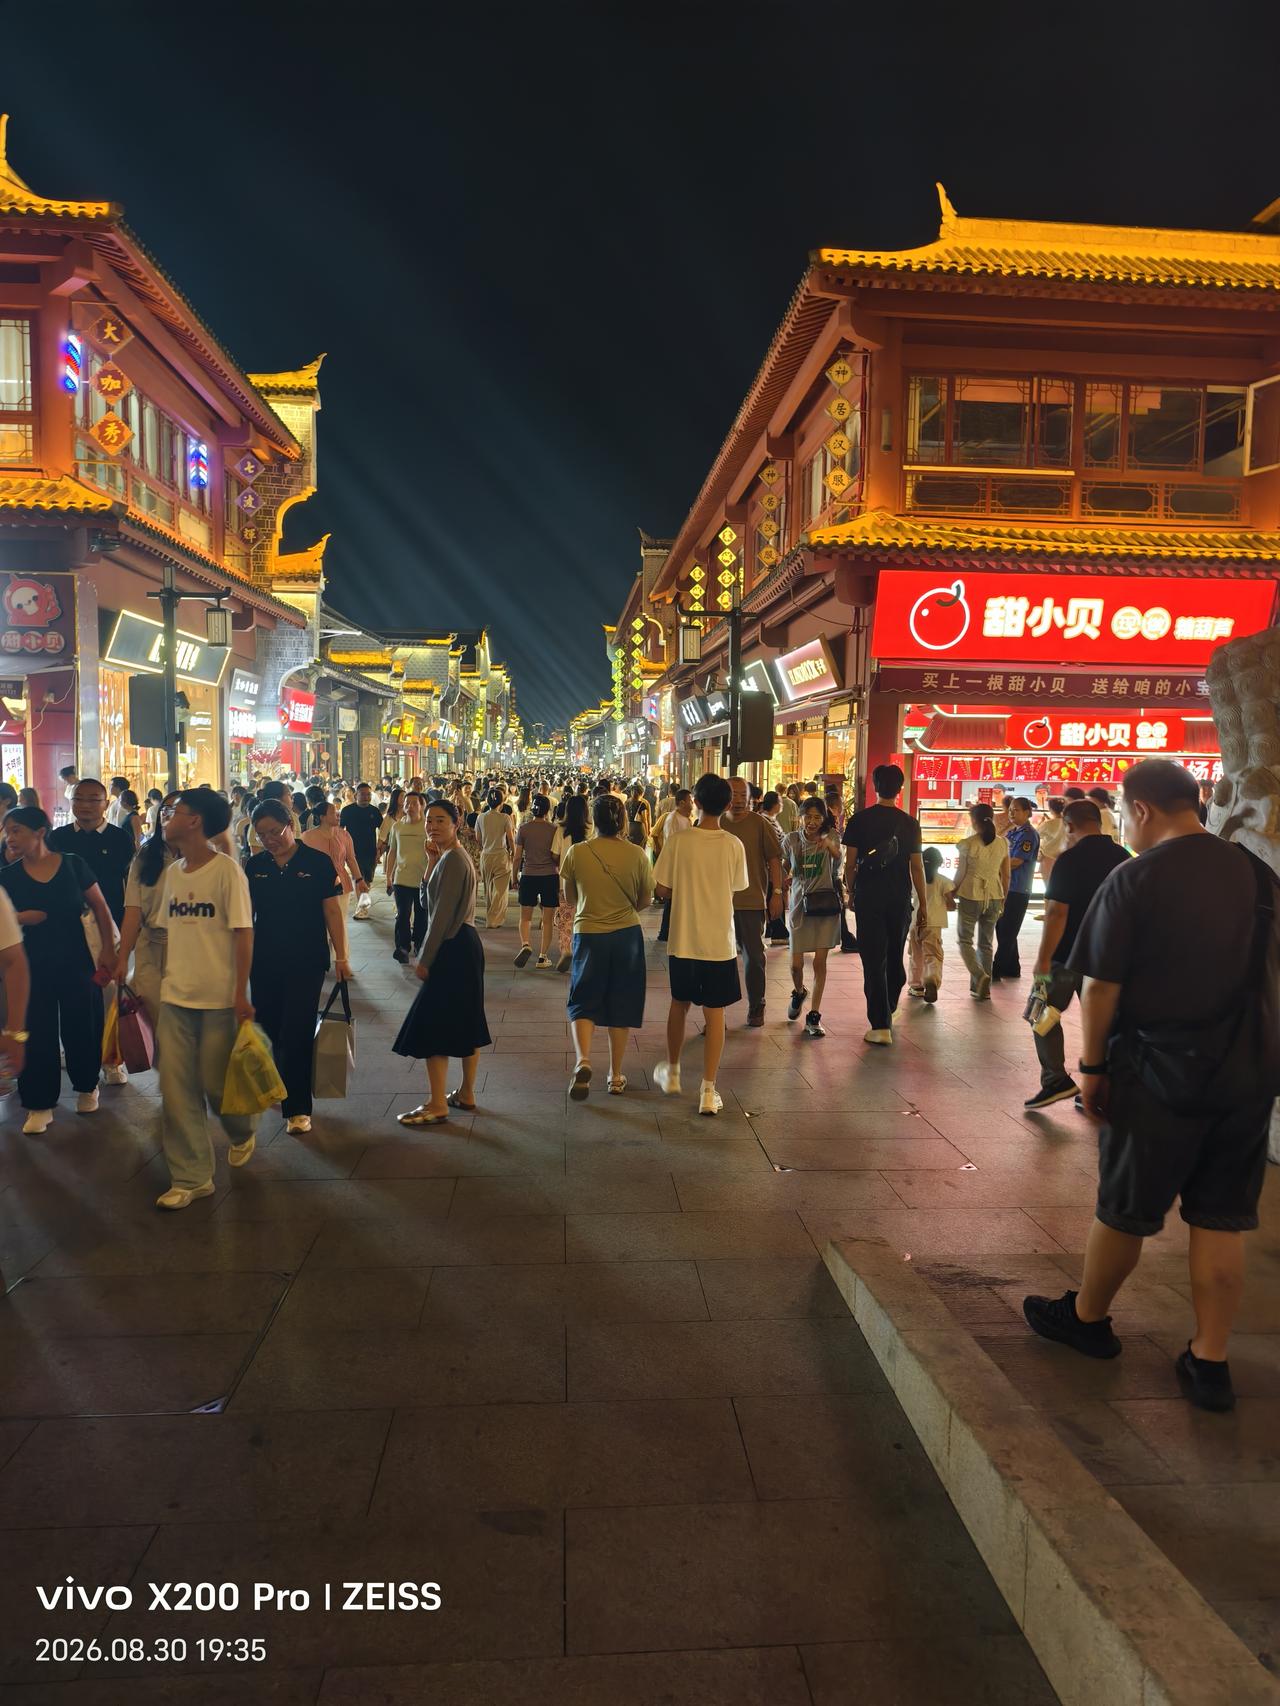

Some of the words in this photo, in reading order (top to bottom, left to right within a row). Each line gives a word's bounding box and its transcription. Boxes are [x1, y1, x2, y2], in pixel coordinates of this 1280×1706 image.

[100, 321, 121, 443] 大咖秀
[832, 366, 849, 487] 神居汉服
[764, 470, 777, 560] 神居汉服
[982, 596, 1104, 640] 甜小贝
[922, 672, 1066, 693] 买上一根甜小贝
[1060, 722, 1131, 747] 甜小贝
